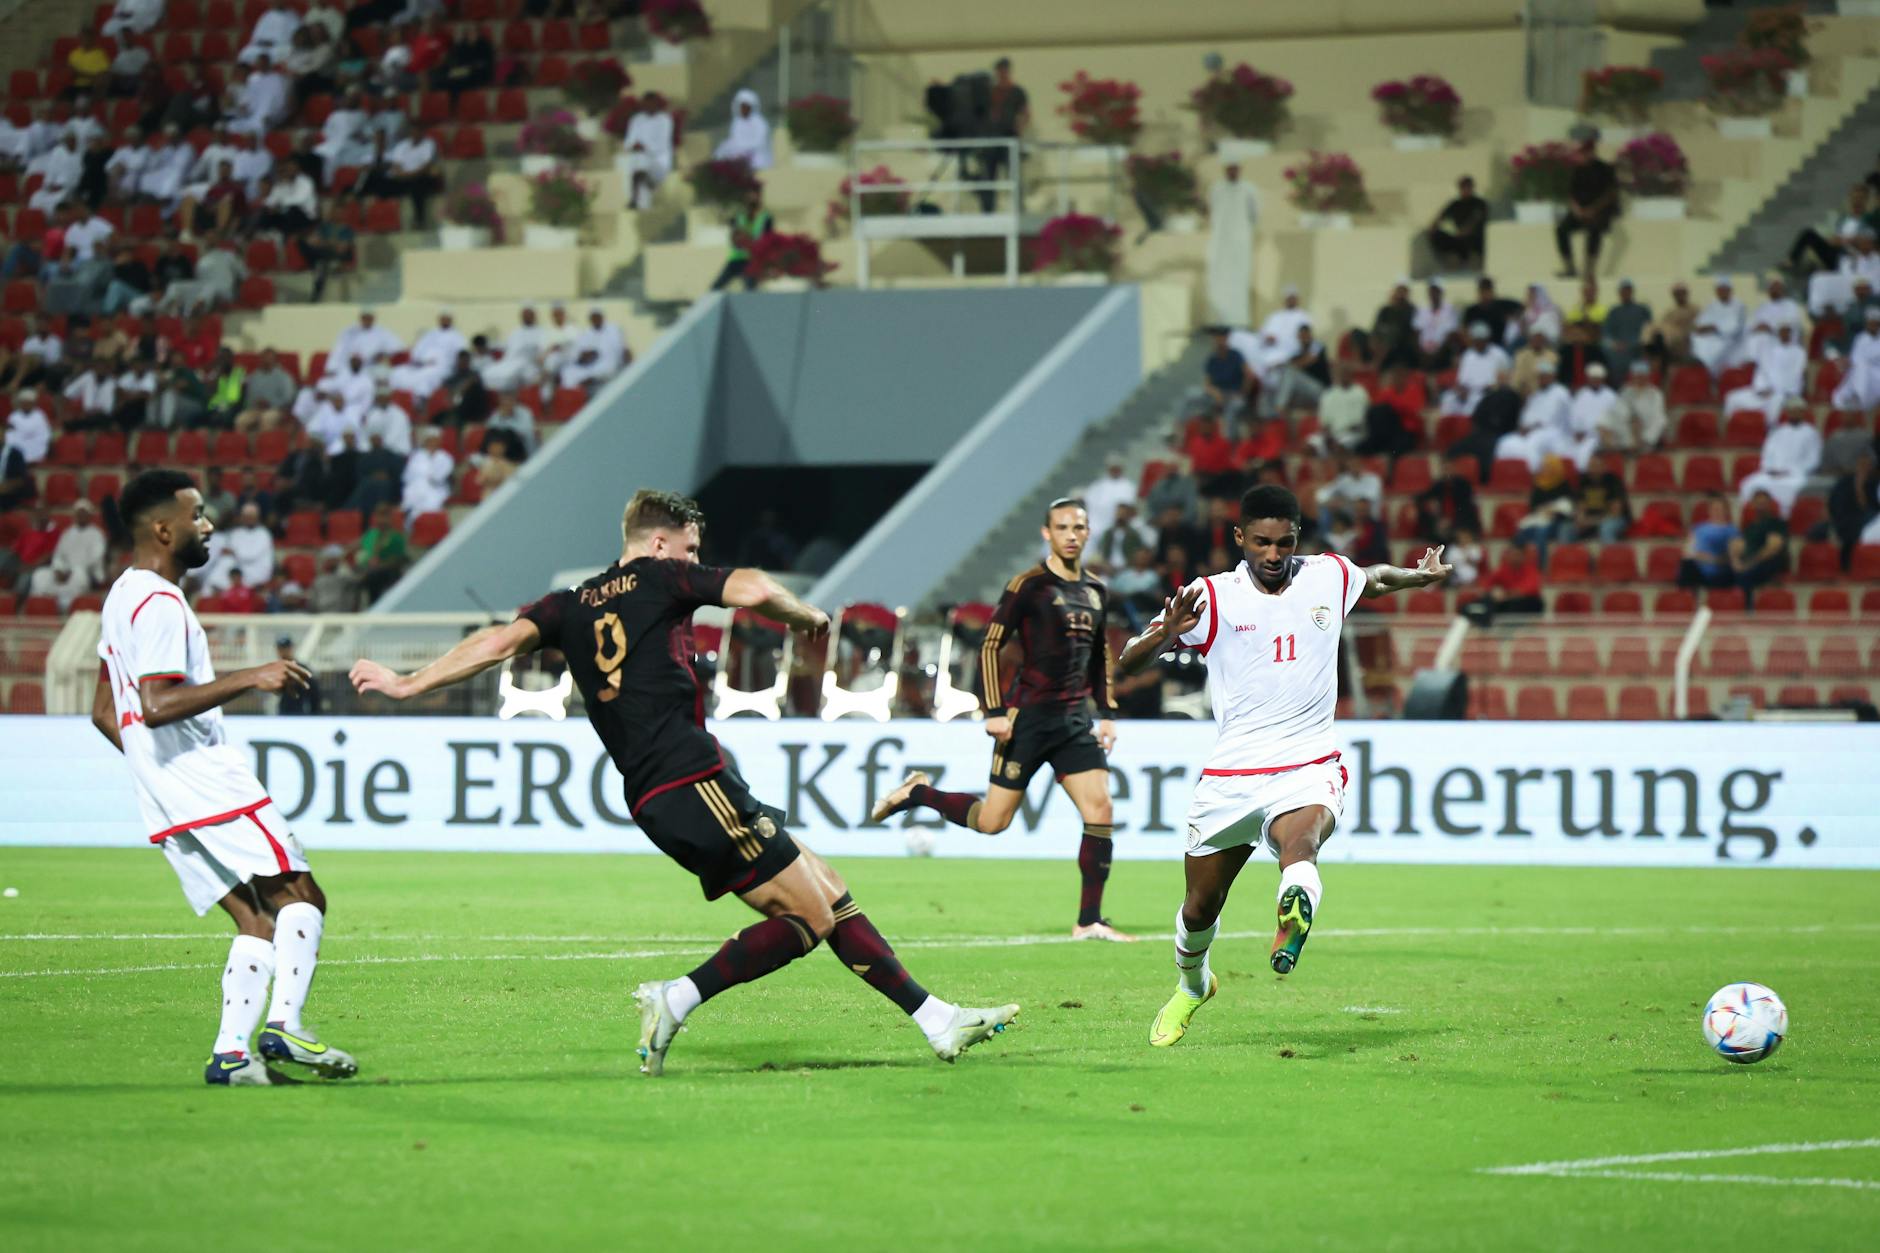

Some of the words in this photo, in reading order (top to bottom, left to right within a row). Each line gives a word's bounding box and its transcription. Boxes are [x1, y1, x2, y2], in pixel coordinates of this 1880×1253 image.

[594, 611, 627, 702] 9
[1235, 624, 1257, 632] JAKO
[1273, 633, 1297, 663] 11
[248, 729, 410, 825] Die
[445, 741, 738, 828] ER
